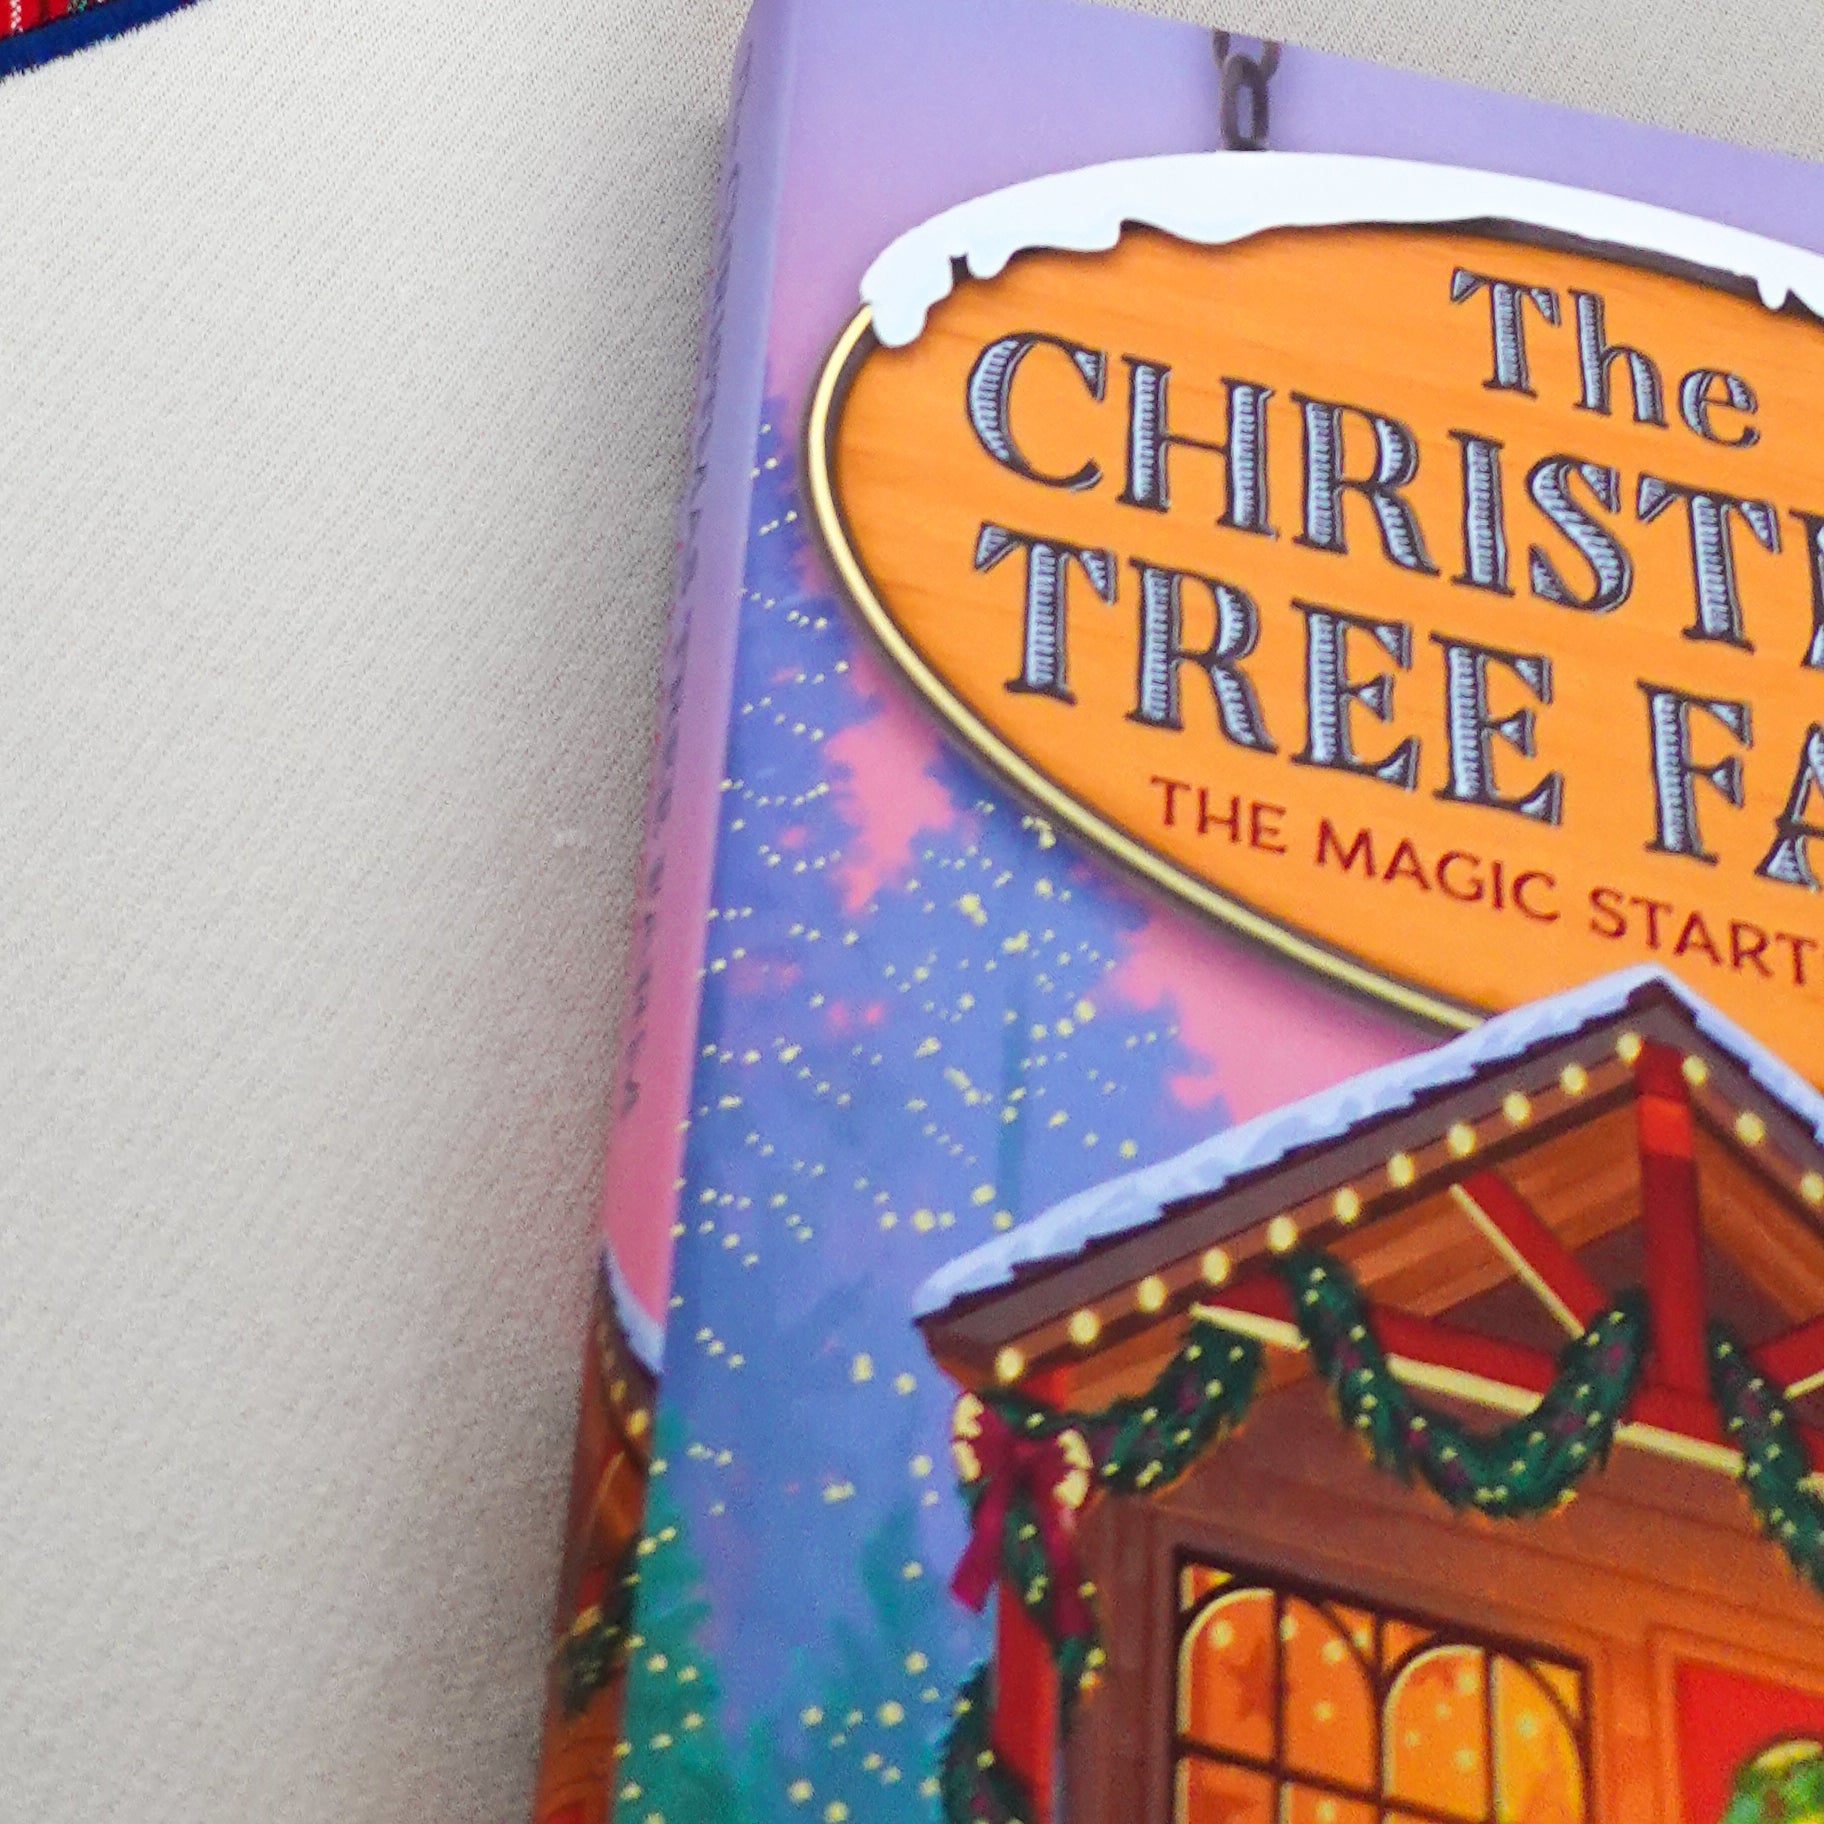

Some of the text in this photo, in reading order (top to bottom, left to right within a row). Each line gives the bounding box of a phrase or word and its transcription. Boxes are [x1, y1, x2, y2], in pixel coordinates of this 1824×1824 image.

[1449, 267, 1761, 451] The
[966, 330, 1824, 670] CHRIST
[975, 520, 1563, 826] TREE
[1149, 775, 1289, 856] THE
[1314, 816, 1558, 923] MAGIC
